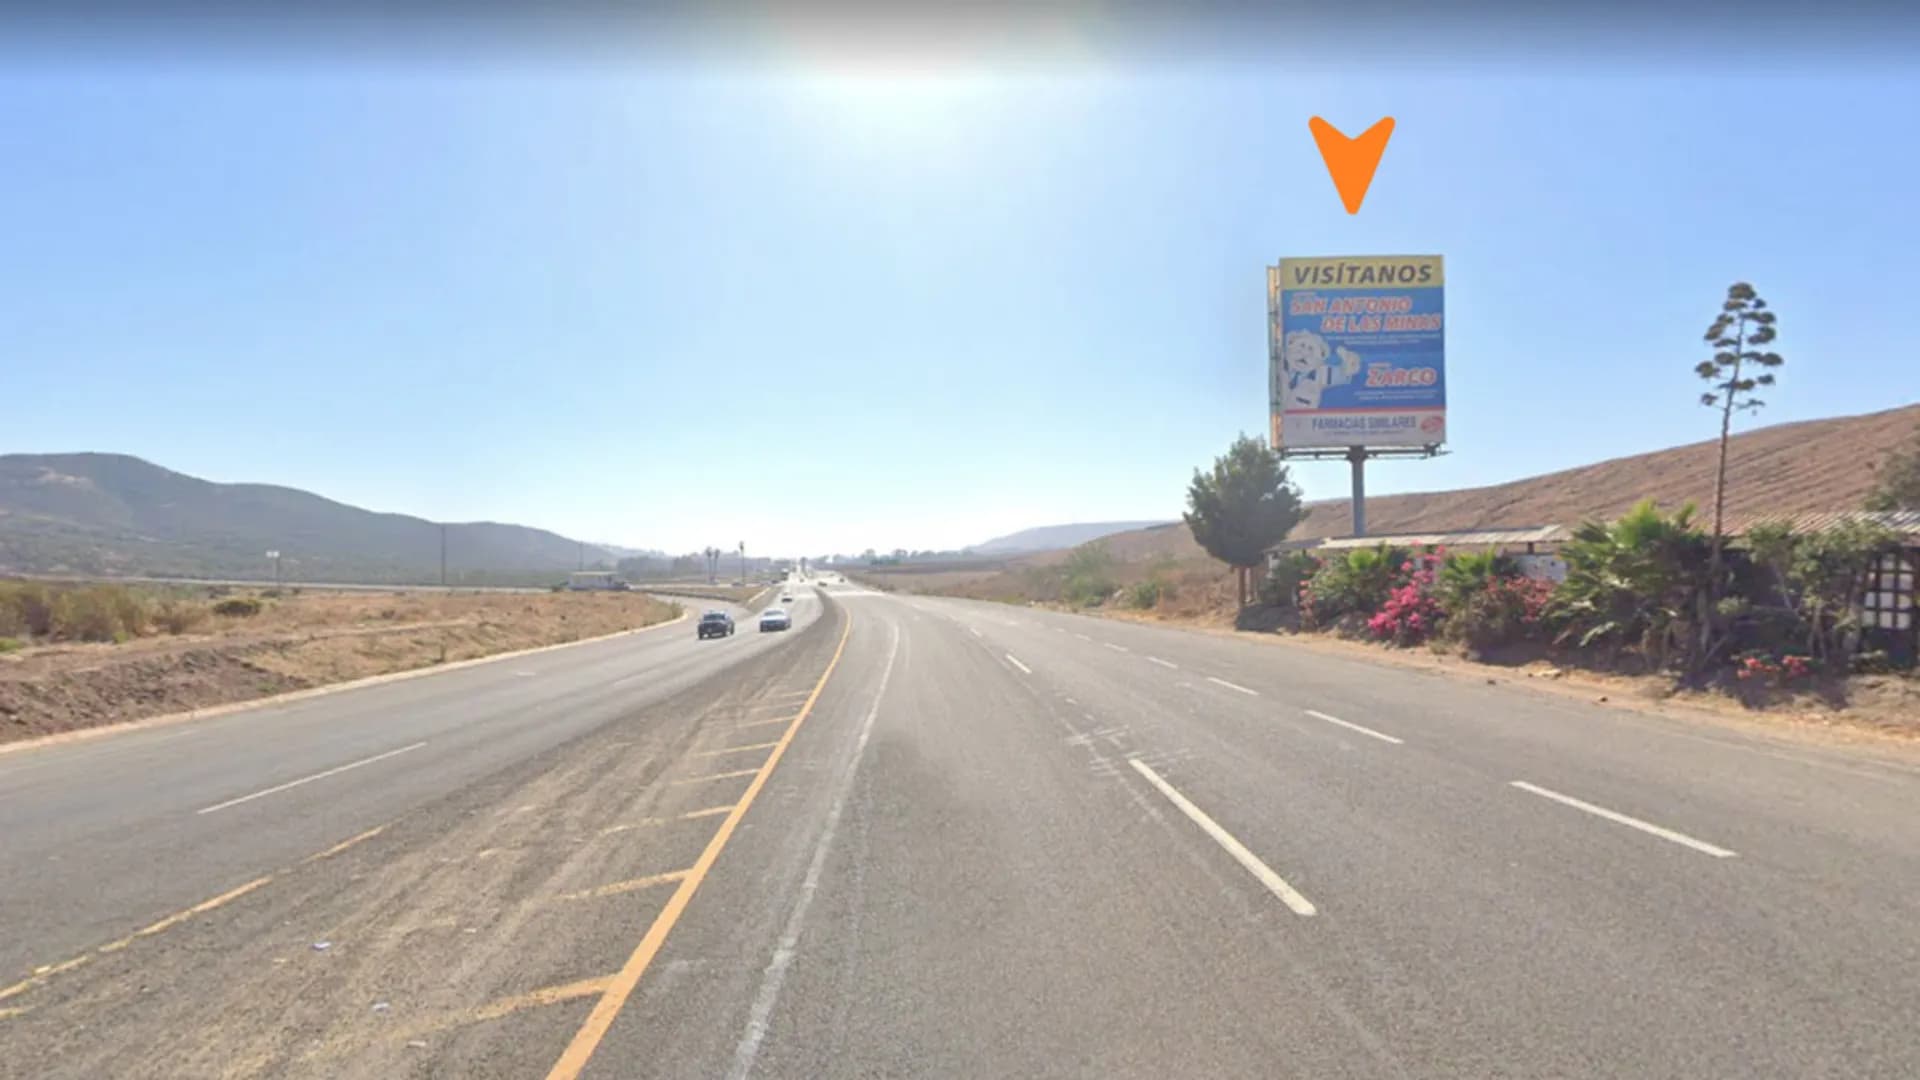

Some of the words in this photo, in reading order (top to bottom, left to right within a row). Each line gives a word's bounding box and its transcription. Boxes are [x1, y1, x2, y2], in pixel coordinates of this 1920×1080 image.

[1294, 262, 1432, 284] VISÍTANOS
[1291, 298, 1327, 315] SAN
[1329, 296, 1412, 314] ANTONIO
[1321, 315, 1346, 333] DE
[1348, 314, 1382, 332] LAS
[1384, 313, 1441, 332] MINAS
[1366, 367, 1438, 387] ZARCO
[1312, 416, 1365, 430] FARMACIAS
